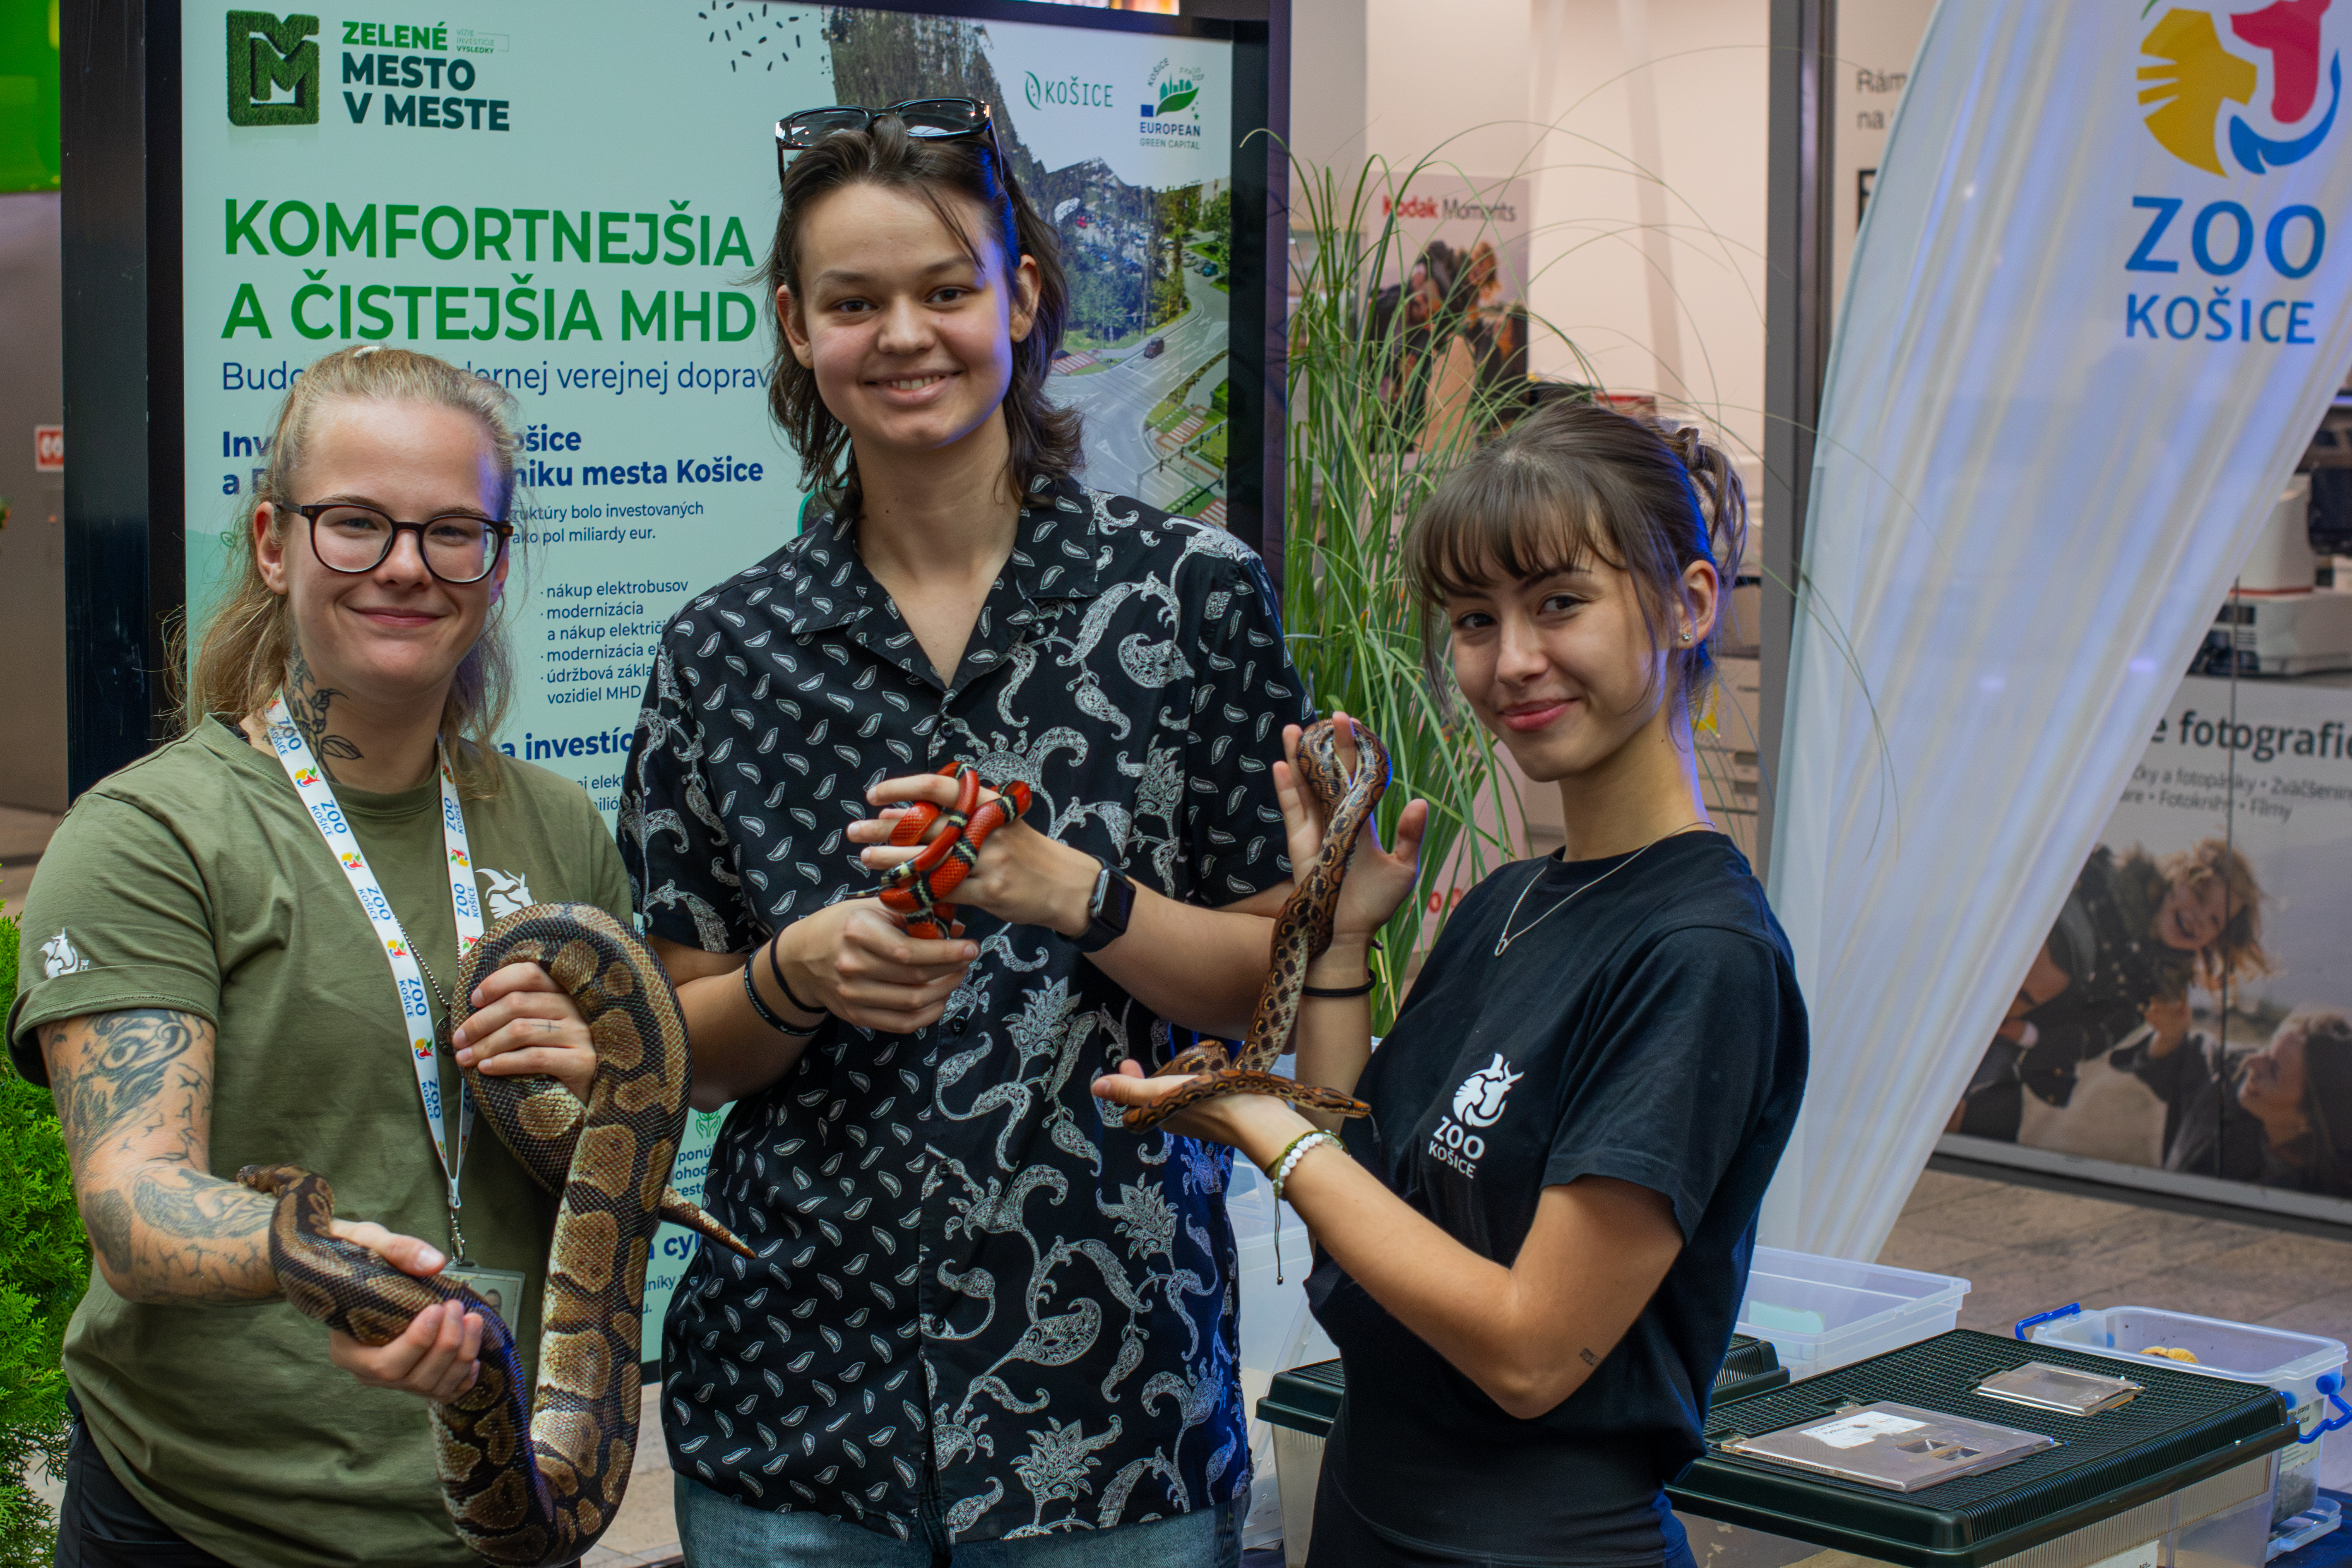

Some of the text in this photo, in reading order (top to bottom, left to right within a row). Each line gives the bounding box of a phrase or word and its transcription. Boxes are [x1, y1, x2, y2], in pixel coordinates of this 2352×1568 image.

[342, 21, 448, 51] ZELENÉ
[342, 52, 475, 91] MESTO
[1046, 76, 1113, 108] KOŠICE
[343, 91, 510, 131] V MESTE
[1140, 122, 1200, 137] EUROPEAN
[1140, 138, 1200, 150] GREEN CAPITAL
[226, 198, 755, 267] KOMFORTNEJŠIA
[2125, 195, 2326, 280] ZOO
[221, 269, 756, 341] A ČISTEJŠIA MHD
[2126, 286, 2315, 344] KOŠICE
[558, 361, 668, 395] verejnej
[582, 461, 667, 486] mesta
[677, 455, 763, 483] Košice
[572, 504, 602, 518] bolo
[606, 501, 703, 519] investovaných
[543, 528, 564, 546] pol
[569, 526, 626, 543] miliardy
[630, 528, 656, 539] eur.
[547, 580, 689, 599] nákup elektrobusov
[547, 601, 643, 619] modernizácia
[548, 620, 666, 641] a nákup električ
[547, 643, 643, 662] modernizácia
[547, 665, 613, 683] údržbová
[547, 685, 641, 704] vozidiel MHD
[310, 805, 334, 838] KOŠICE
[320, 800, 347, 834] ZOO
[444, 798, 457, 832] ZOO
[358, 889, 380, 923] KOŠICE
[366, 886, 391, 921] ZOO
[454, 883, 469, 918] ZOO
[468, 885, 480, 918] KOŠICE
[398, 980, 414, 1018] KOŠICE
[407, 976, 427, 1016] ZOO
[428, 1078, 441, 1119] ZOO
[1433, 1115, 1485, 1160] ZOO
[1429, 1140, 1477, 1179] KOŠICE
